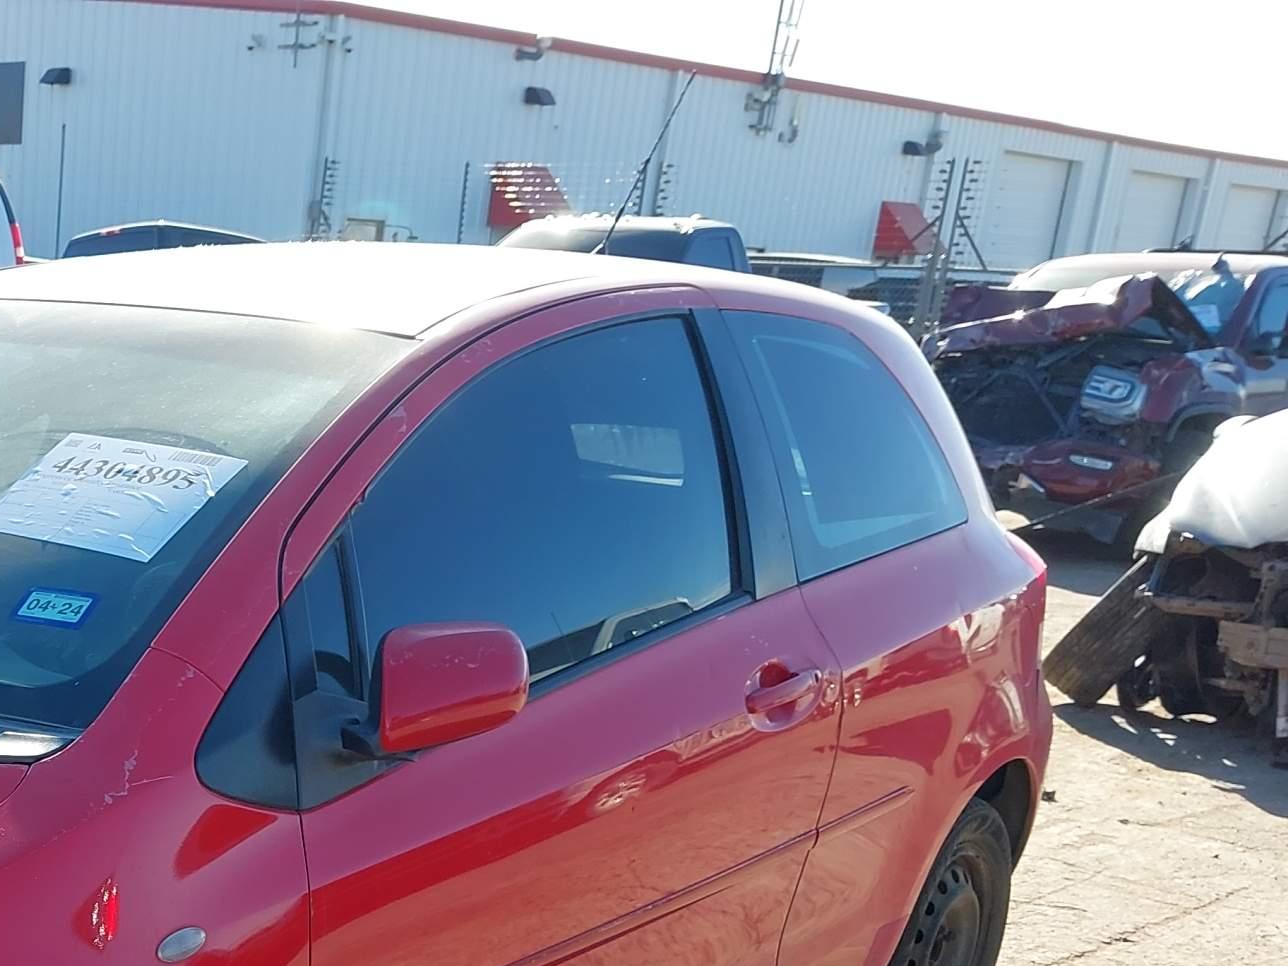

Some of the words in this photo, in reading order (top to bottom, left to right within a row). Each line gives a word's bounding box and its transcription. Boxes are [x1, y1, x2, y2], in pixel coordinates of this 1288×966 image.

[52, 455, 202, 490] 44304895
[26, 598, 51, 612] 04
[56, 602, 84, 617] 24
